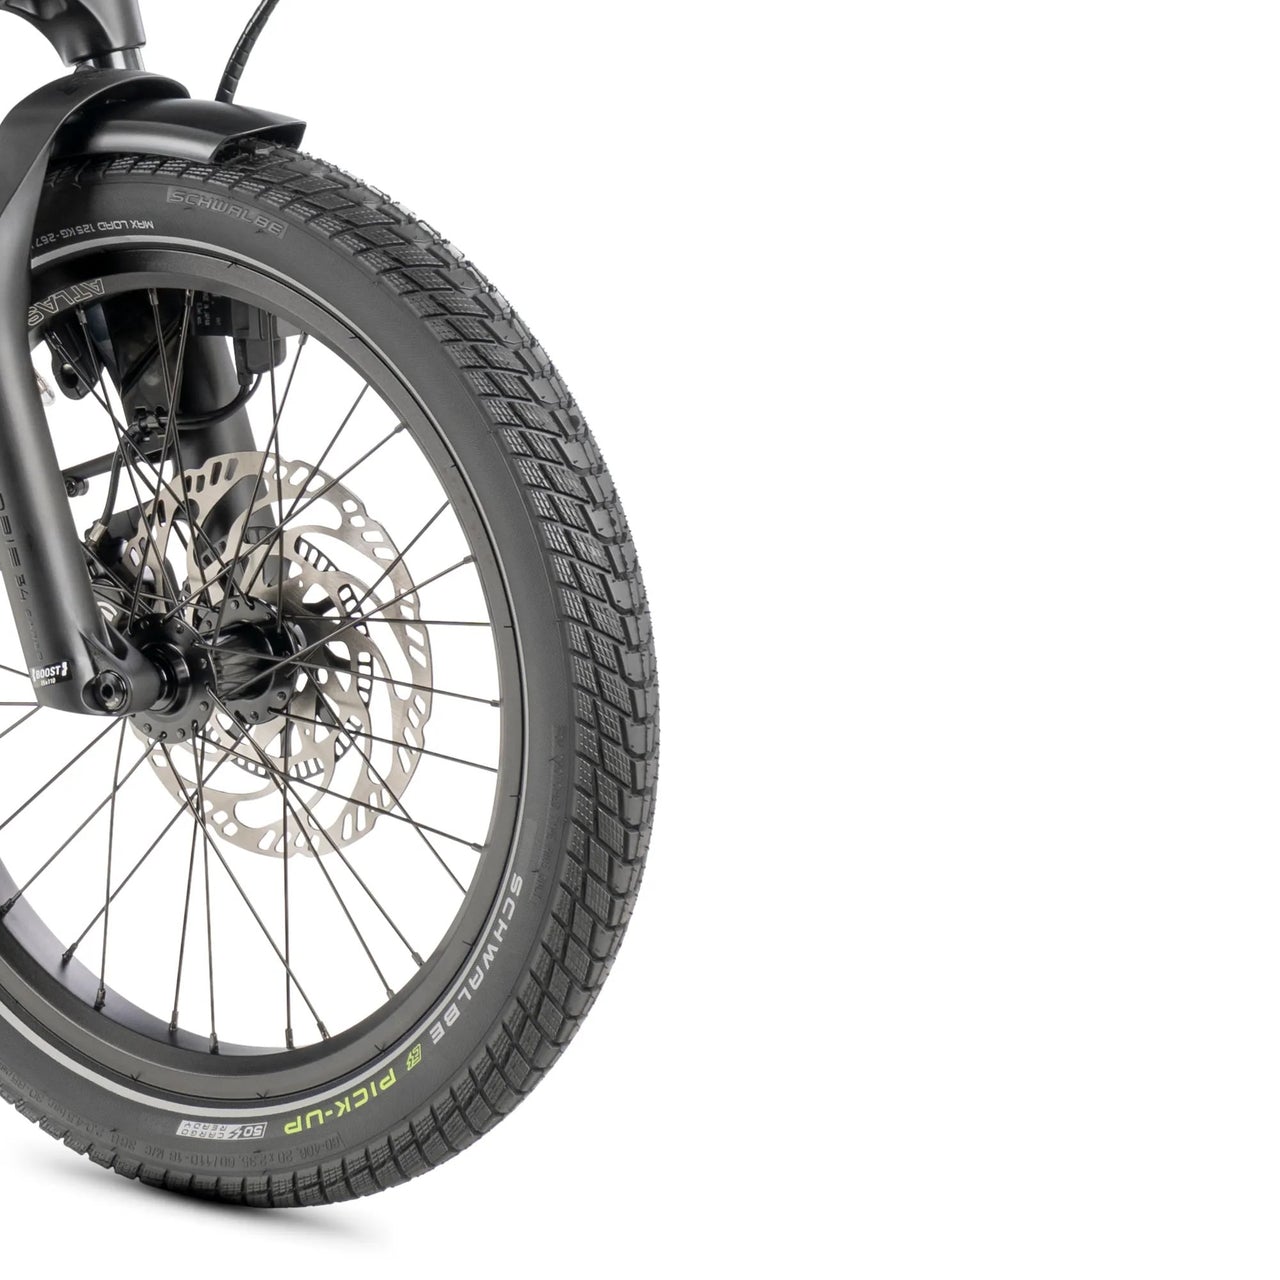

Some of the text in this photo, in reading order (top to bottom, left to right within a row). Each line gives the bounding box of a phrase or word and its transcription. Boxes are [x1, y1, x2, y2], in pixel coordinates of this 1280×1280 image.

[170, 189, 284, 237] SCHWALBE
[97, 218, 128, 231] LOAD
[130, 218, 154, 229] MAX
[15, 573, 29, 602] 34
[35, 665, 61, 679] BOOST
[284, 873, 523, 1136] SCHWALBE PICK-UP
[183, 1121, 228, 1132] READY
[243, 1124, 264, 1137] 50
[181, 1128, 224, 1139] CARGO
